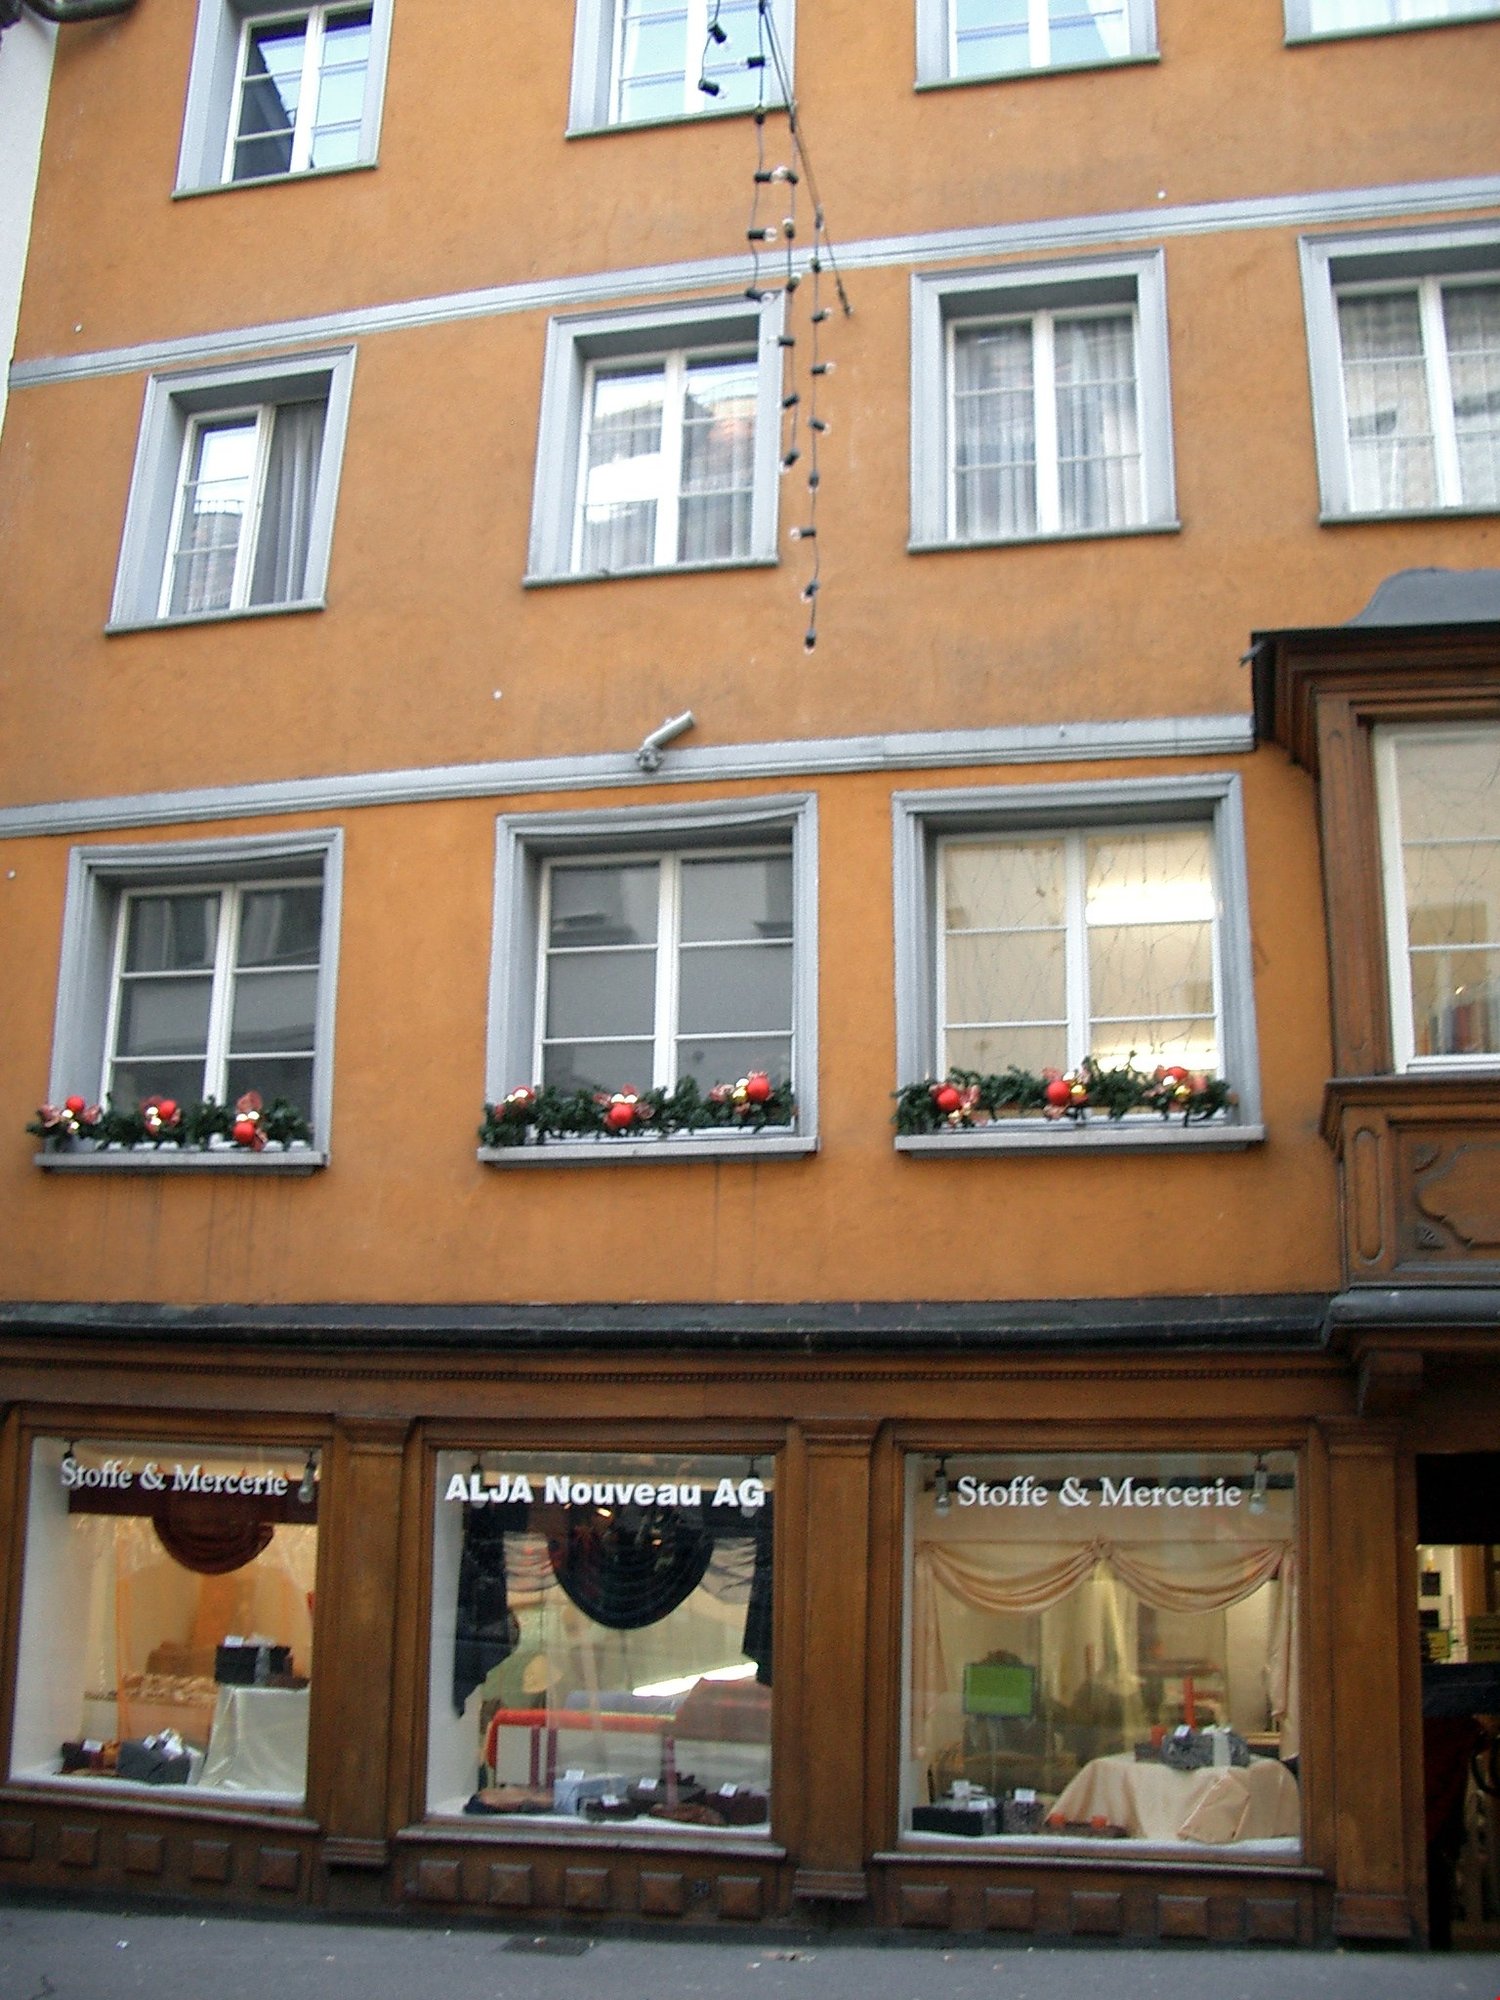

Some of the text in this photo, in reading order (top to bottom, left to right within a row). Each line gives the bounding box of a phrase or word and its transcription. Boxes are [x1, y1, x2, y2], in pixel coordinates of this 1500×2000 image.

[61, 1457, 288, 1496] Stoffe & Mercerie
[444, 1473, 765, 1508] ALJA Nouveau AG
[957, 1475, 1243, 1508] Stoffe & Mercerie
